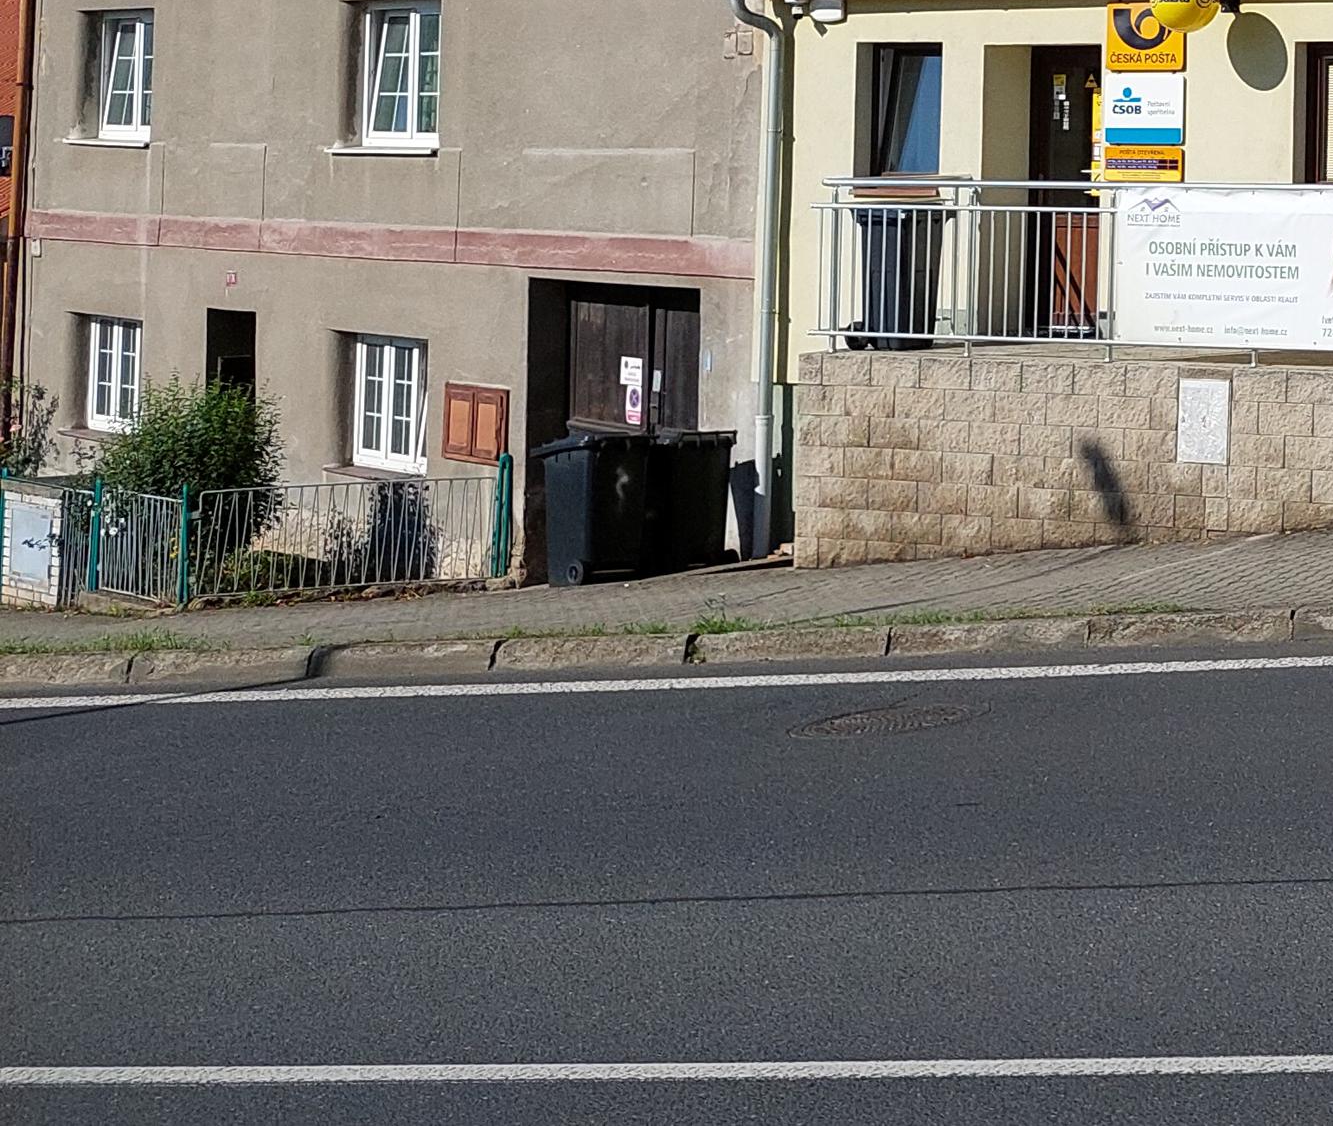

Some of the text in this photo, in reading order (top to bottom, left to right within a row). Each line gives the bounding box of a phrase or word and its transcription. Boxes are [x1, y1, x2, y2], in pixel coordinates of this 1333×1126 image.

[1110, 52, 1177, 63] ČESKÁ POŠTA
[1112, 103, 1142, 114] ČSOB
[1127, 214, 1181, 223] NEXT HOME
[1149, 238, 1297, 258] OSOBNÍ PŘÍSTUP K VÁM
[1145, 260, 1299, 280] I VAŠIM NEMOVITOSTEM
